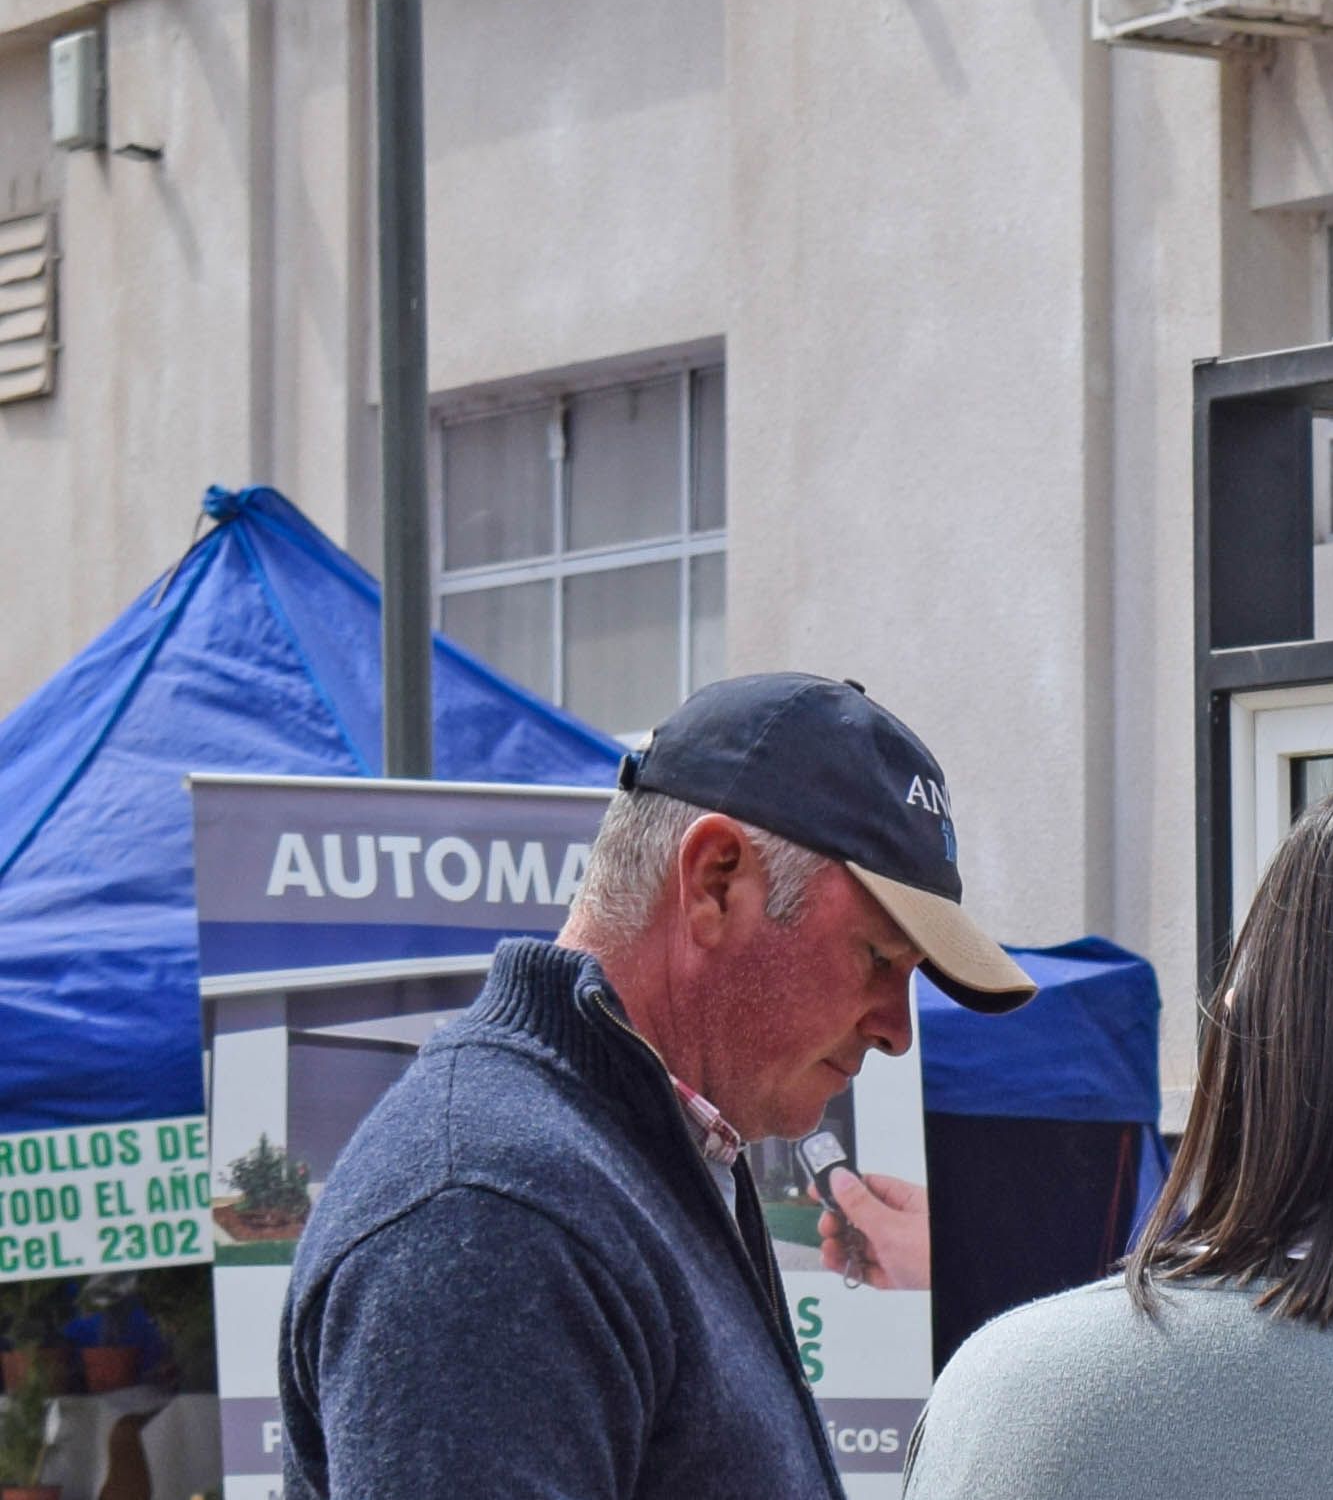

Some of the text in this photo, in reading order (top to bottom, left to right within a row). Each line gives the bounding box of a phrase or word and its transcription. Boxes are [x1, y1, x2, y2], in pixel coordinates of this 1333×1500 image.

[0, 1123, 206, 1176] ROLLOS DE
[95, 1180, 134, 1218] EL
[147, 1166, 211, 1213] AÑO
[98, 1219, 202, 1264] 2302
